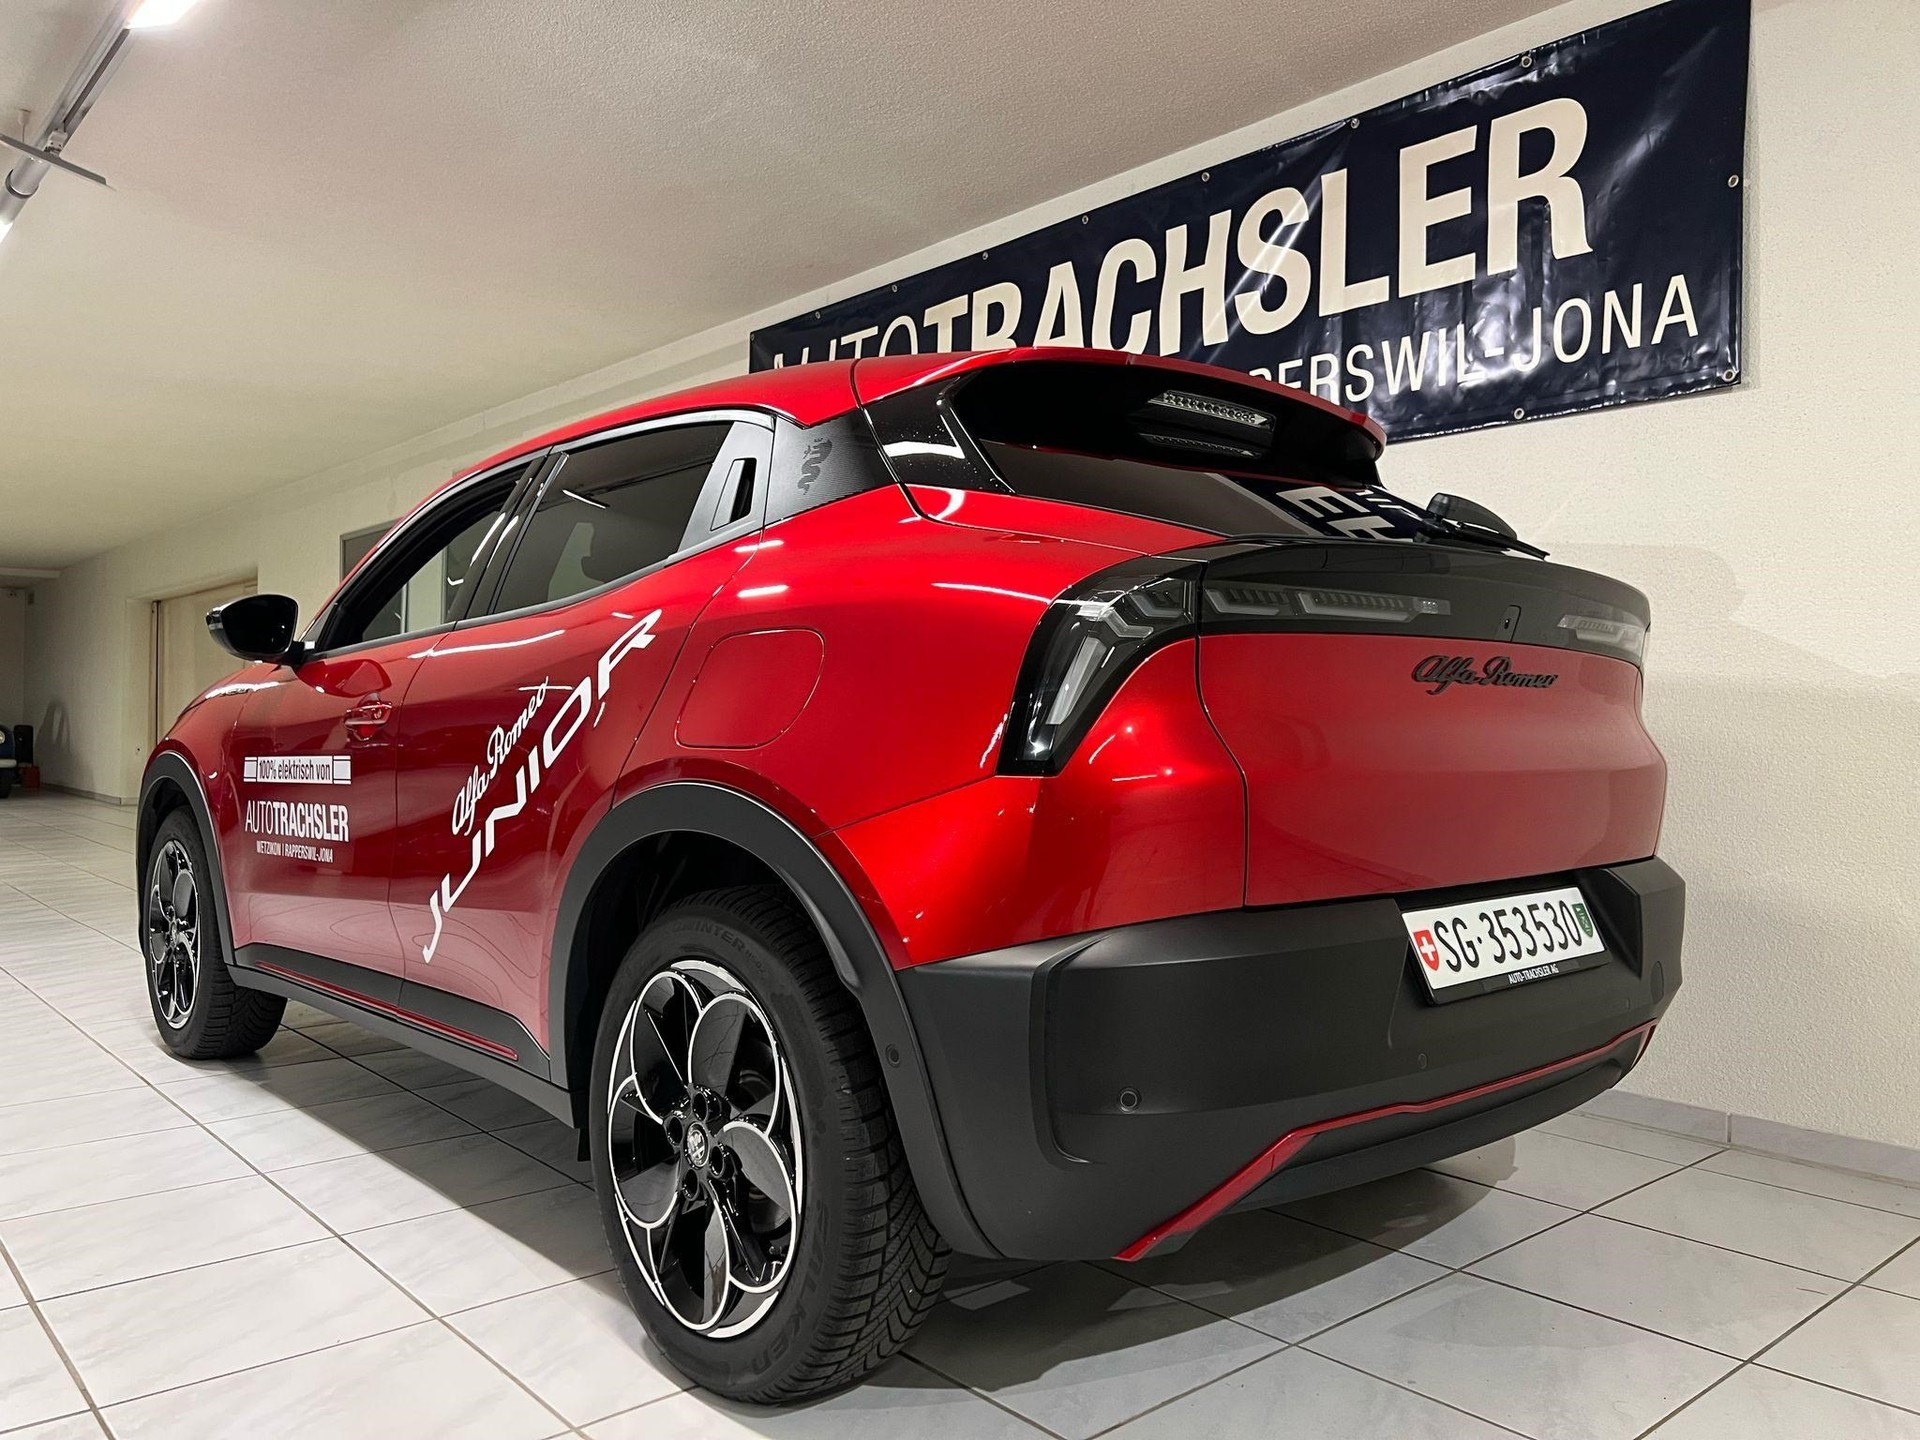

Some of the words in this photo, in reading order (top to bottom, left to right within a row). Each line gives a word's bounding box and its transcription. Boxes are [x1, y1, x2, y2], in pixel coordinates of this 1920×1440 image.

[1411, 655, 1480, 696] Alfa
[1480, 655, 1559, 688] Romeo
[259, 760, 277, 780] 100%
[278, 759, 315, 780] elektrisch
[316, 763, 331, 780] von
[452, 764, 490, 836] Alfa
[486, 676, 550, 780] Romeo
[422, 608, 663, 964] JUNIOR
[244, 800, 350, 842] AUTOTRACHSLER
